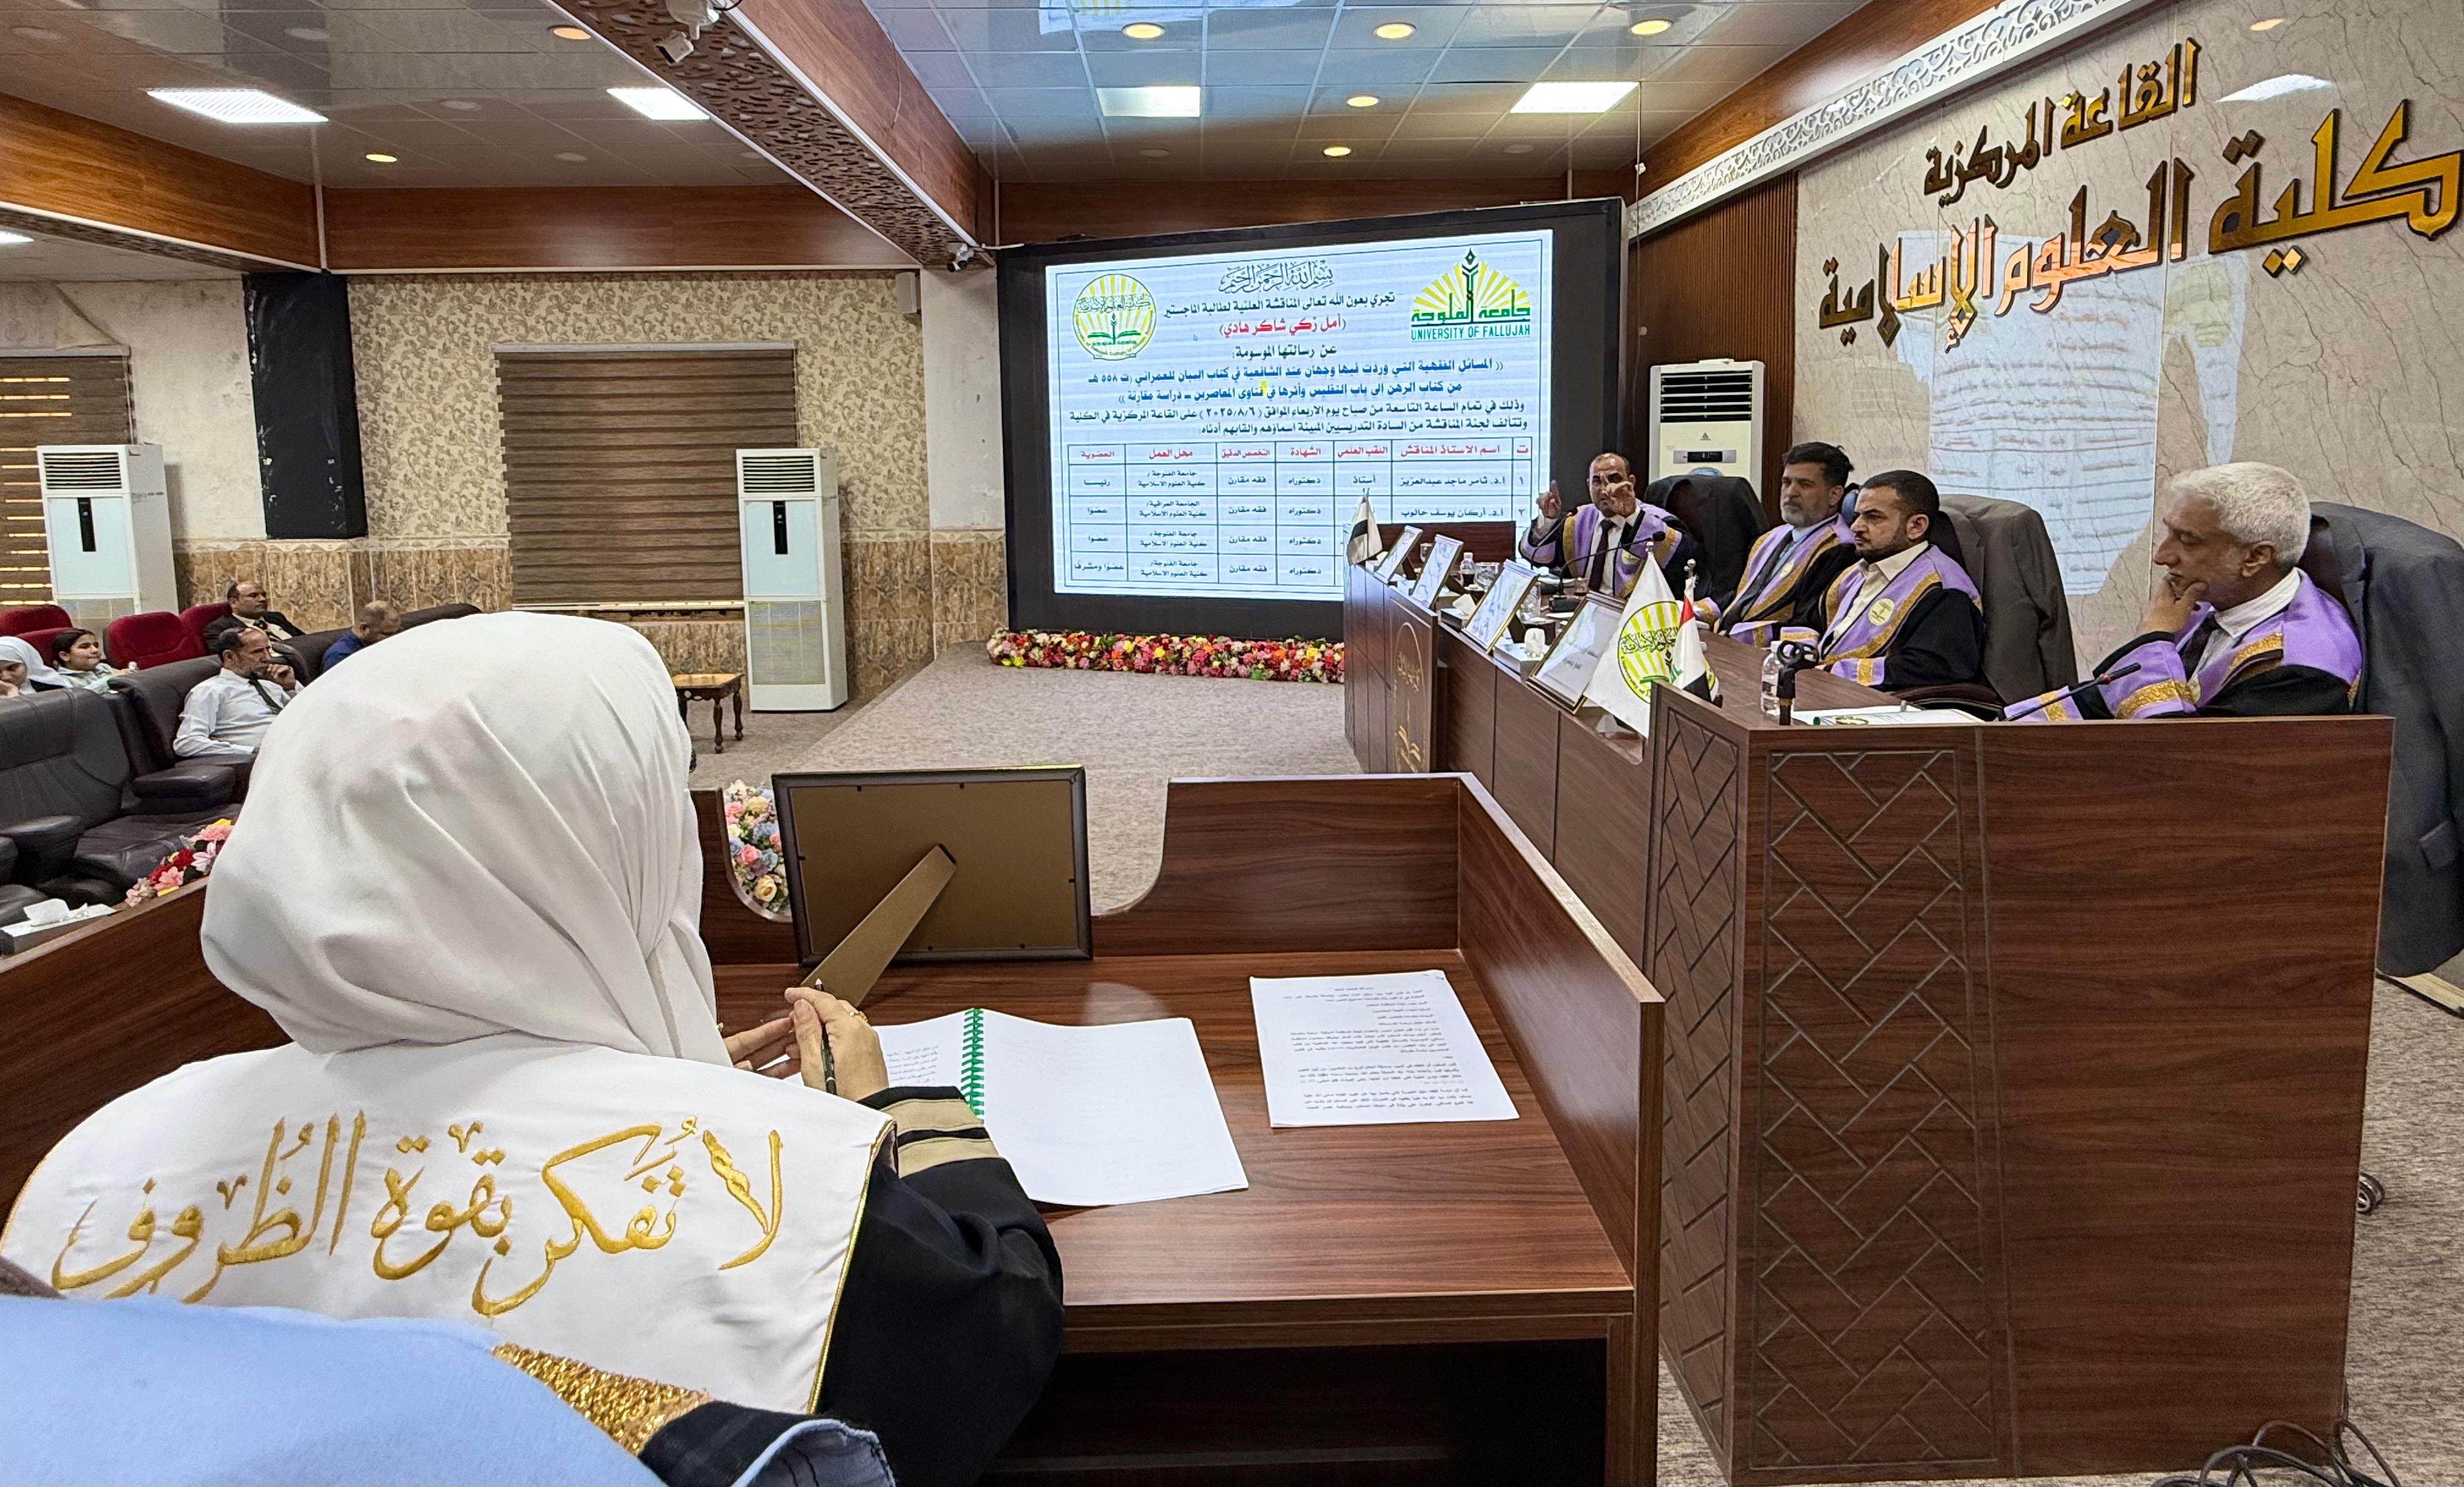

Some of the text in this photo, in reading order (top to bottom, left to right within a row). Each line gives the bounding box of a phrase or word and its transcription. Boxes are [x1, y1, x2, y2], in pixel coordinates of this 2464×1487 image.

[1922, 36, 2202, 208] القاعة المركزية
[2206, 99, 2463, 278] كلية
[1994, 157, 2196, 315] العلوم
[1163, 292, 1396, 318] تجري بعون الله تعالى المناقشة العلنية لطالبة الماجستير
[1251, 317, 1286, 335] شاكر
[1289, 317, 1318, 336] زكي
[1411, 324, 1530, 340] UNIVERSITY OF FALLUJAH
[1278, 344, 1315, 359] رسالتها
[1320, 344, 1337, 358] عن
[1285, 366, 1302, 376] عند
[1305, 364, 1336, 378] وجهان
[1338, 362, 1359, 376] فيها
[1362, 364, 1388, 375] وردت
[1392, 361, 1415, 376] التي
[1418, 359, 1454, 373] الفقهية
[1458, 357, 1492, 372] المسائل
[1101, 373, 1118, 383] ٥٥٨
[1135, 370, 1175, 386] للعمراني
[1178, 369, 1204, 383] البيان
[1207, 367, 1229, 381] كتاب
[1231, 367, 1241, 383] في
[1244, 366, 1282, 380] الشافعية
[1266, 384, 1276, 400] في
[1310, 384, 1347, 397] التفليس
[1350, 383, 1368, 397] باب
[1387, 381, 1415, 395] الرهن
[1419, 380, 1445, 394] كتاب
[1447, 382, 1462, 394] من
[1128, 390, 1154, 403] مقارنة
[1156, 389, 1182, 402] دراسة
[1194, 387, 1236, 402] المعاصرين
[1342, 405, 1368, 417] صباح
[1369, 405, 1384, 416] من
[1385, 402, 1422, 413] التاسعة
[1425, 401, 1459, 412] الساعة
[1461, 400, 1482, 414] تمام
[1485, 399, 1497, 414] في
[1498, 398, 1525, 412] وذلك
[1069, 410, 1099, 423] الكلية
[1101, 410, 1110, 424] في
[1112, 409, 1149, 422] المركزية
[1151, 409, 1178, 419] القاعة
[1179, 408, 1197, 420] على
[1264, 406, 1289, 419] الموافق
[1325, 407, 1340, 417] يوم
[1297, 422, 1324, 433] المبينة
[1325, 421, 1375, 434] التدريسيين
[1377, 419, 1407, 430] السادة
[1408, 420, 1424, 432] من
[1426, 418, 1464, 429] المناقشة
[1465, 417, 1490, 431] لجنة
[1492, 417, 1528, 430] وتتألف
[1080, 450, 1115, 460] العضوية
[1148, 448, 1194, 460] محل العمل
[1221, 449, 1271, 460] التخصص الدقيق
[1290, 447, 1322, 458] الشهادة
[1337, 446, 1388, 458] اللقب العلمي
[1400, 444, 1500, 458] اسم الاستاذ المناقش
[1516, 445, 1529, 454] ت
[1227, 475, 1267, 486] فقه مقارن
[1288, 475, 1322, 488] دكتوراه
[1352, 475, 1376, 485] أستاذ
[1444, 477, 1467, 486] ماجد
[1228, 505, 1267, 515] فقه مقارن
[1288, 508, 1321, 516] دكتوراه
[1228, 535, 1251, 545] مقارن
[1288, 538, 1322, 547] دكتوراه
[1229, 565, 1251, 574] مقارن
[1289, 568, 1322, 576] دكتوراه
[702, 1129, 783, 1271] لا
